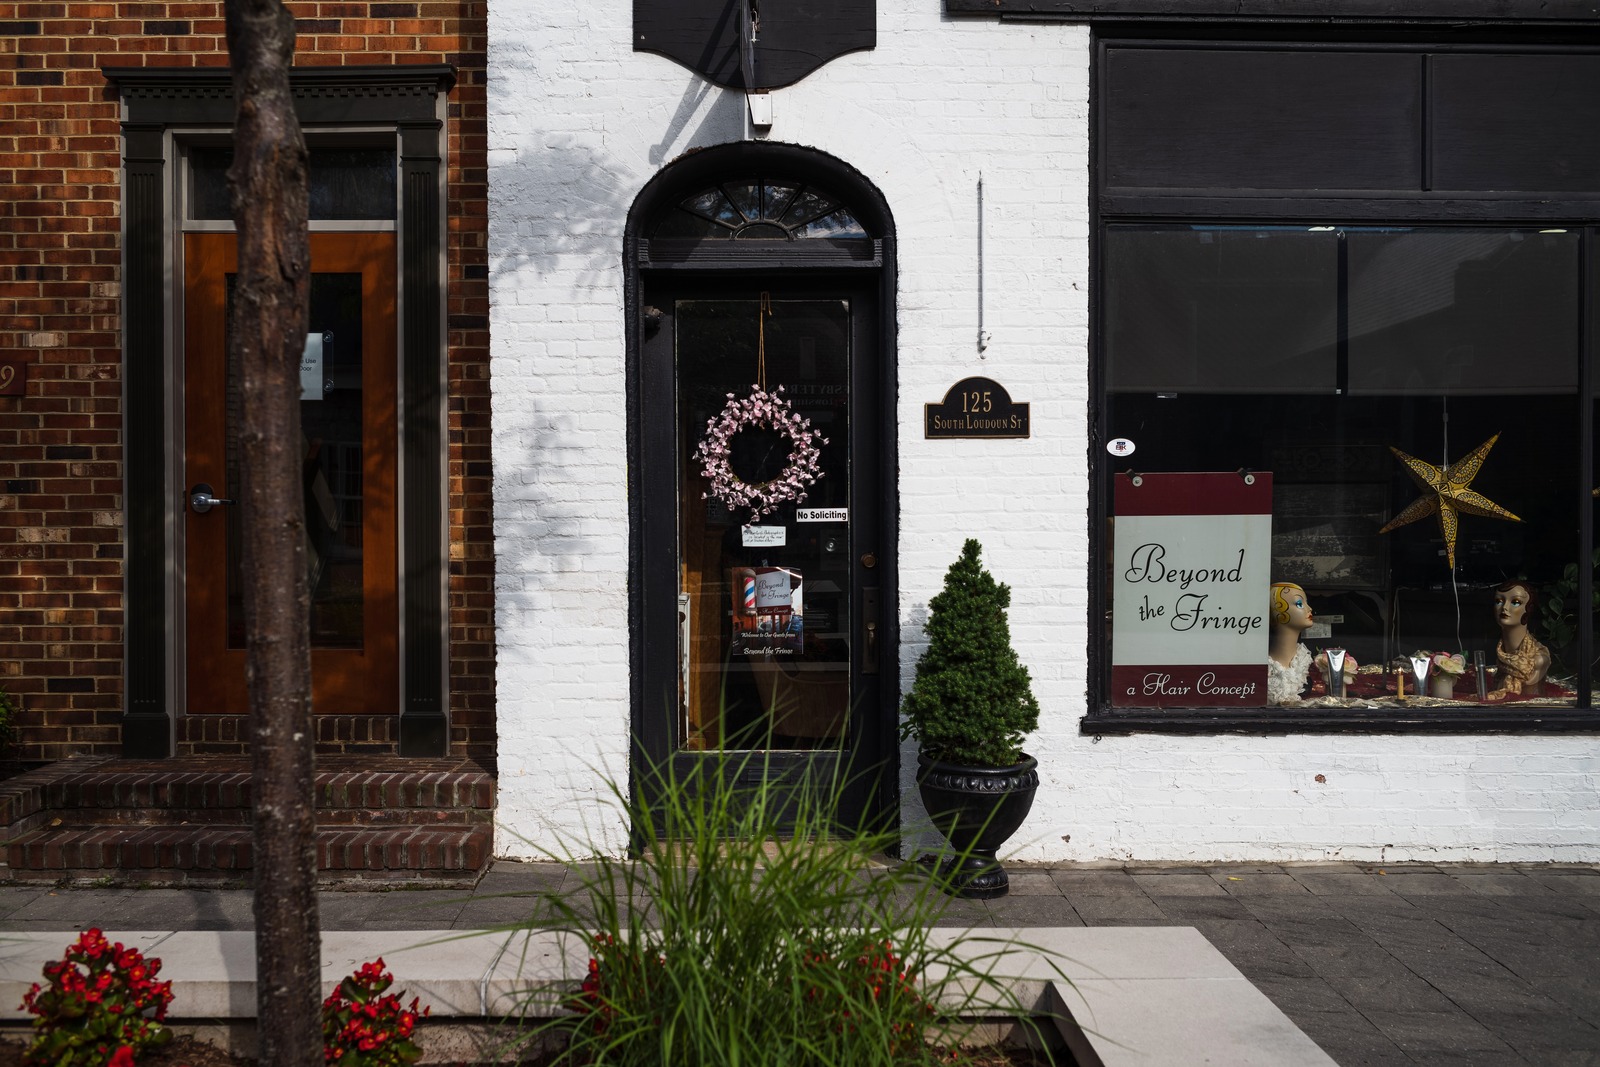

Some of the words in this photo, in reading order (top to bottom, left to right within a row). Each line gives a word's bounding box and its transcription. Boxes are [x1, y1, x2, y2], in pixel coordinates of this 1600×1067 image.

[962, 391, 992, 413] 125
[797, 511, 808, 520] No
[810, 511, 847, 521] Soliciting
[1124, 543, 1245, 590] Beyond
[758, 578, 785, 591] Beyond
[1138, 595, 1165, 622] the
[1170, 593, 1262, 635] Fringe
[743, 646, 765, 655] Beyond
[774, 647, 793, 655] Fringe
[1126, 686, 1136, 695] a
[1143, 672, 1191, 696] Hair
[1196, 671, 1256, 699] Concept
